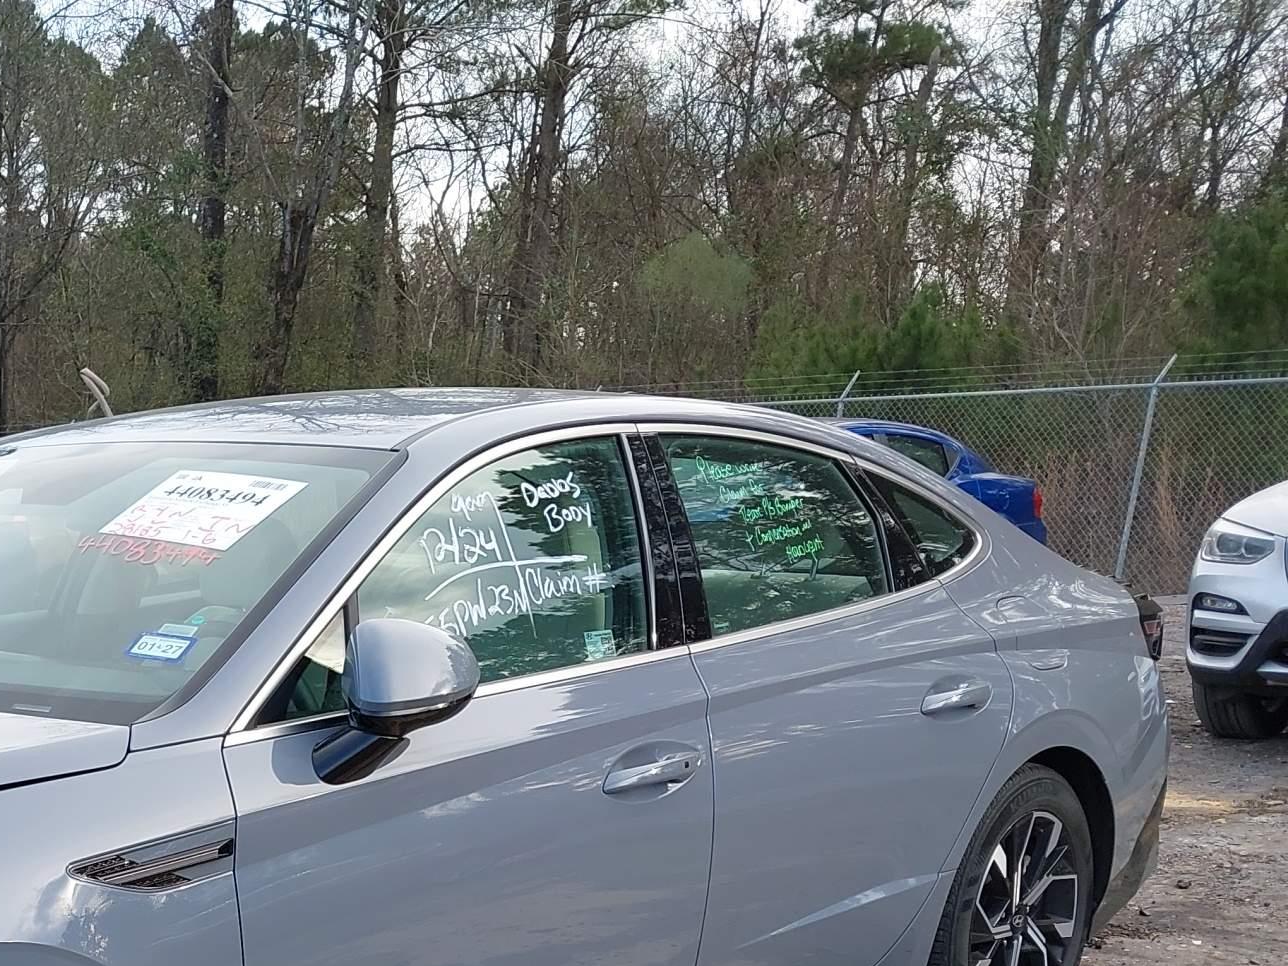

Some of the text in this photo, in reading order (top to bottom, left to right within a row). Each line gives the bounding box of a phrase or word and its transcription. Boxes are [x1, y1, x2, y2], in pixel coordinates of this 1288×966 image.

[164, 484, 271, 507] 44083494
[78, 533, 221, 567] 44083494
[418, 517, 503, 575] 12/24
